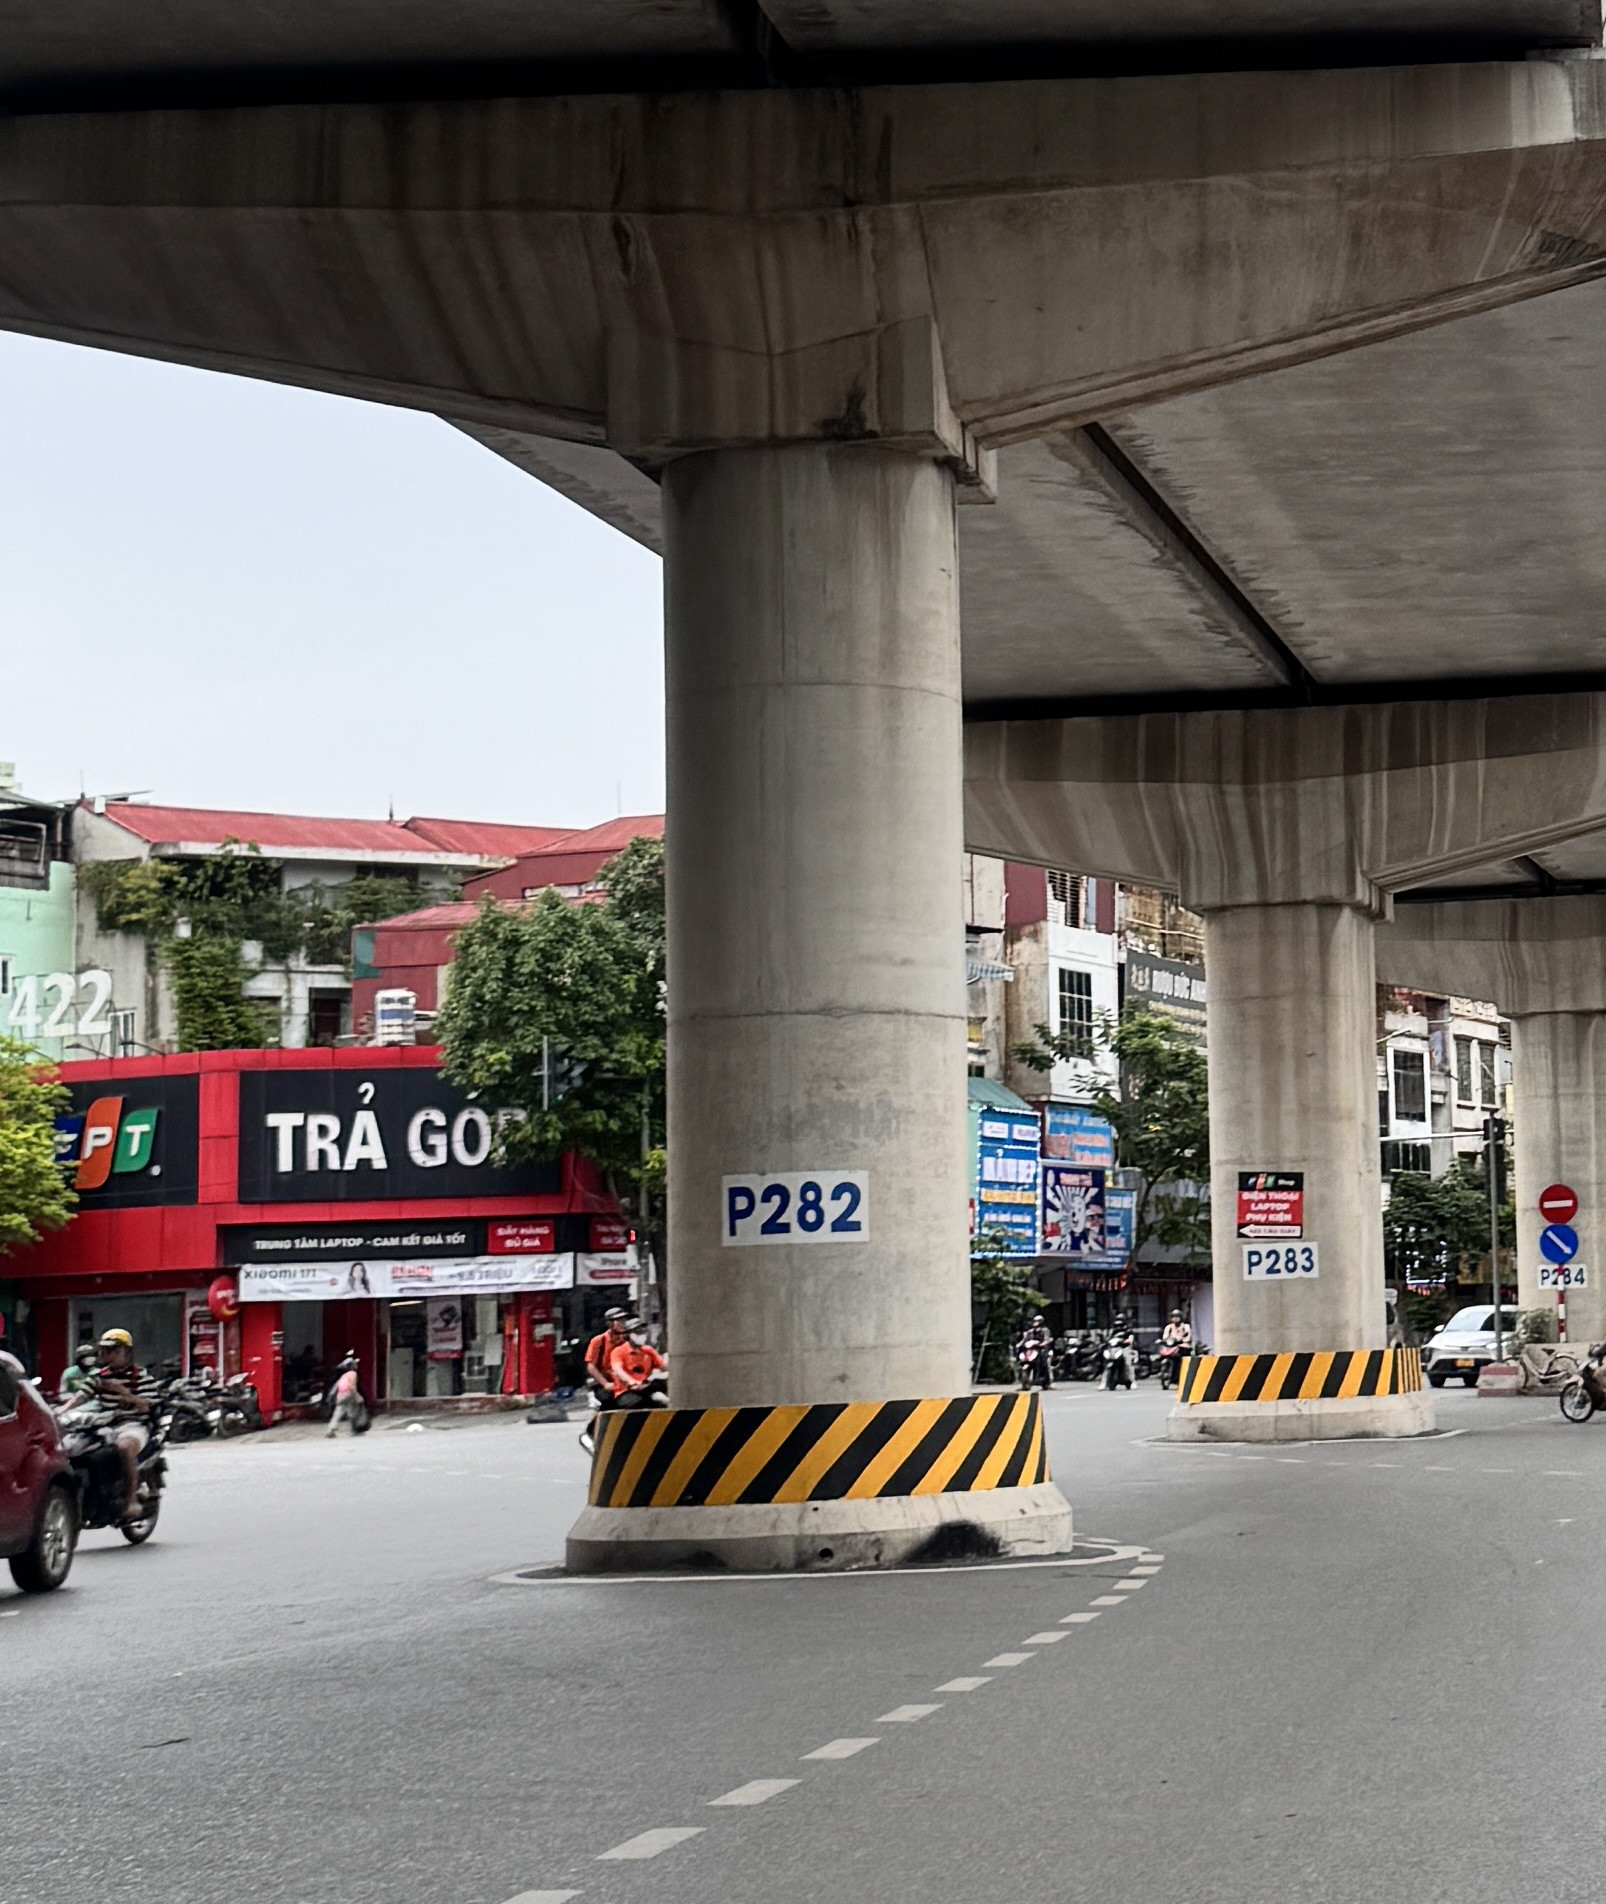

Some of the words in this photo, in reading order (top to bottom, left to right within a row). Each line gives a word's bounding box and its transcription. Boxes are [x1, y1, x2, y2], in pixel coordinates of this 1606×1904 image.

[8, 969, 113, 1038] 422
[265, 1081, 388, 1173] TRẢ
[728, 1180, 862, 1237] P282
[1250, 1202, 1290, 1211] LAPTOP
[254, 1239, 293, 1250] TRUNG
[294, 1236, 318, 1249] TÂM
[320, 1237, 365, 1248] LAPTOP
[372, 1236, 401, 1247] CAM
[401, 1233, 421, 1246] KẾT
[446, 1233, 467, 1245] TỐT
[1246, 1246, 1315, 1275] P283
[1540, 1267, 1586, 1286] P284
